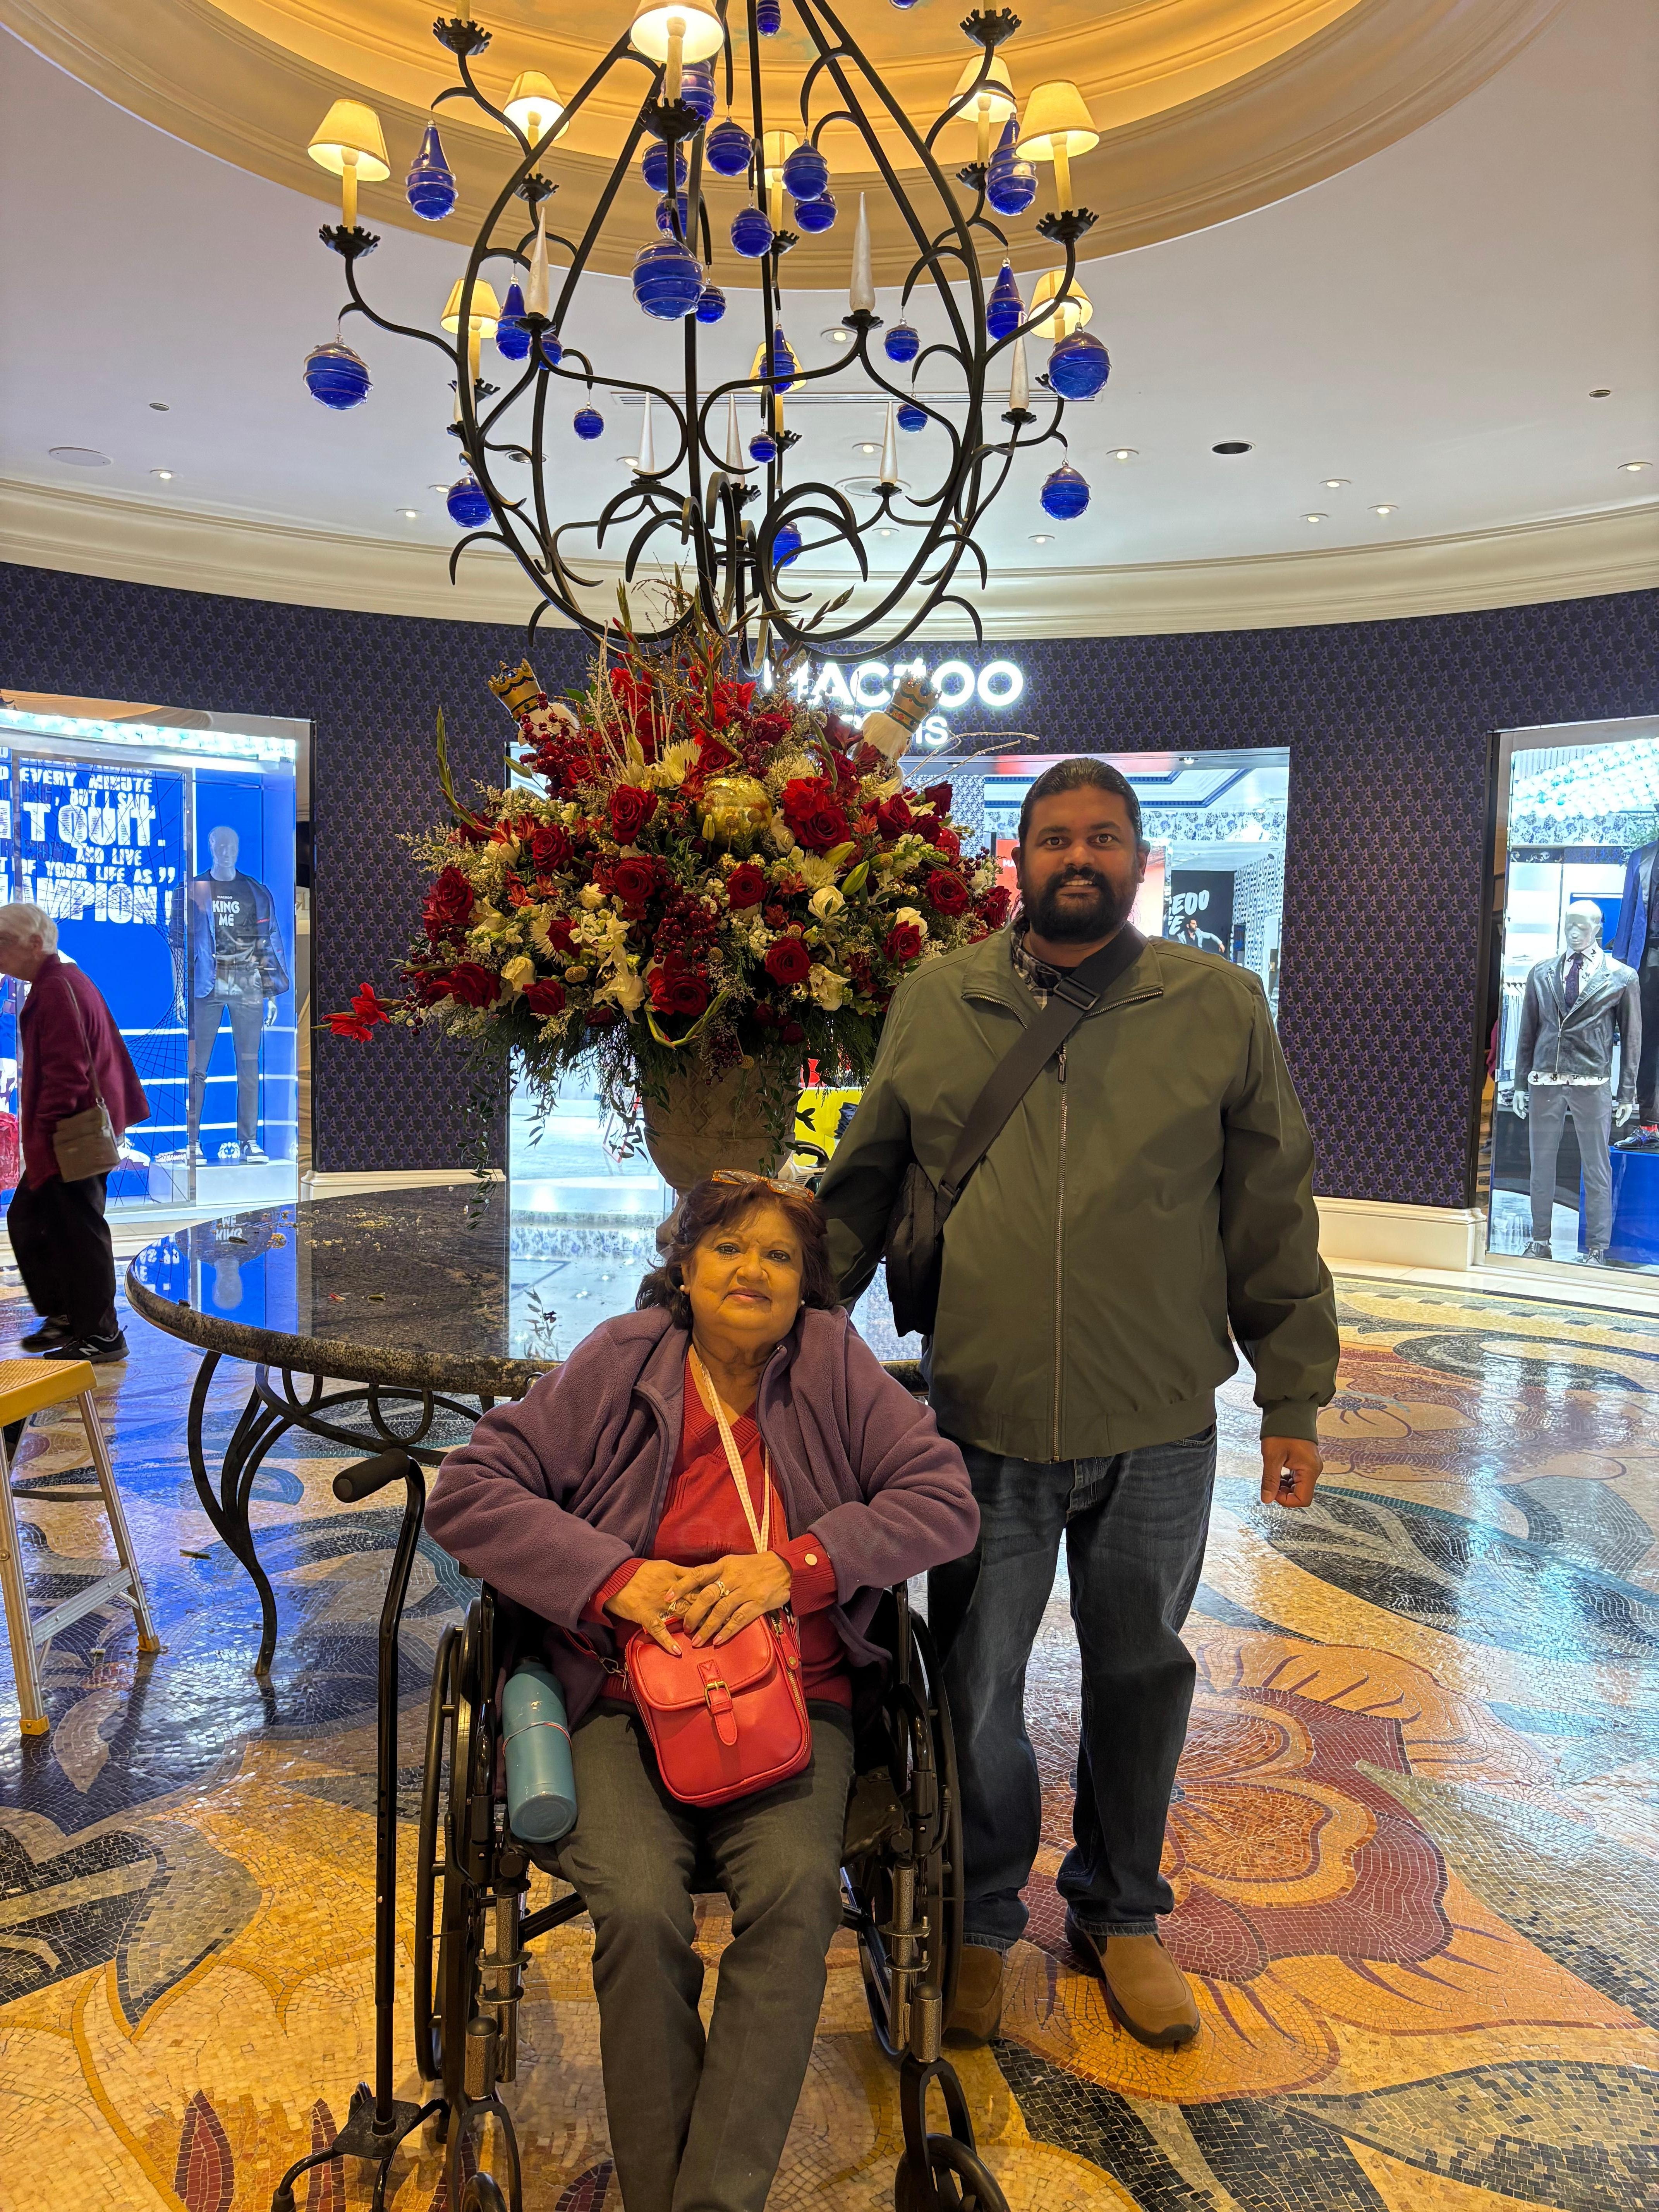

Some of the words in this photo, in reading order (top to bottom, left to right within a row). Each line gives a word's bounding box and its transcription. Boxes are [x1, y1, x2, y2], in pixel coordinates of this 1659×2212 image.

[19, 767, 77, 787] EVERY
[88, 775, 152, 793] MINUTE
[70, 788, 97, 807] BUT
[76, 846, 105, 864] AND
[112, 848, 142, 866] LIVE
[45, 861, 87, 879] YOUR
[96, 866, 125, 882] LIFE
[212, 900, 240, 914] KING
[219, 914, 234, 927] ME
